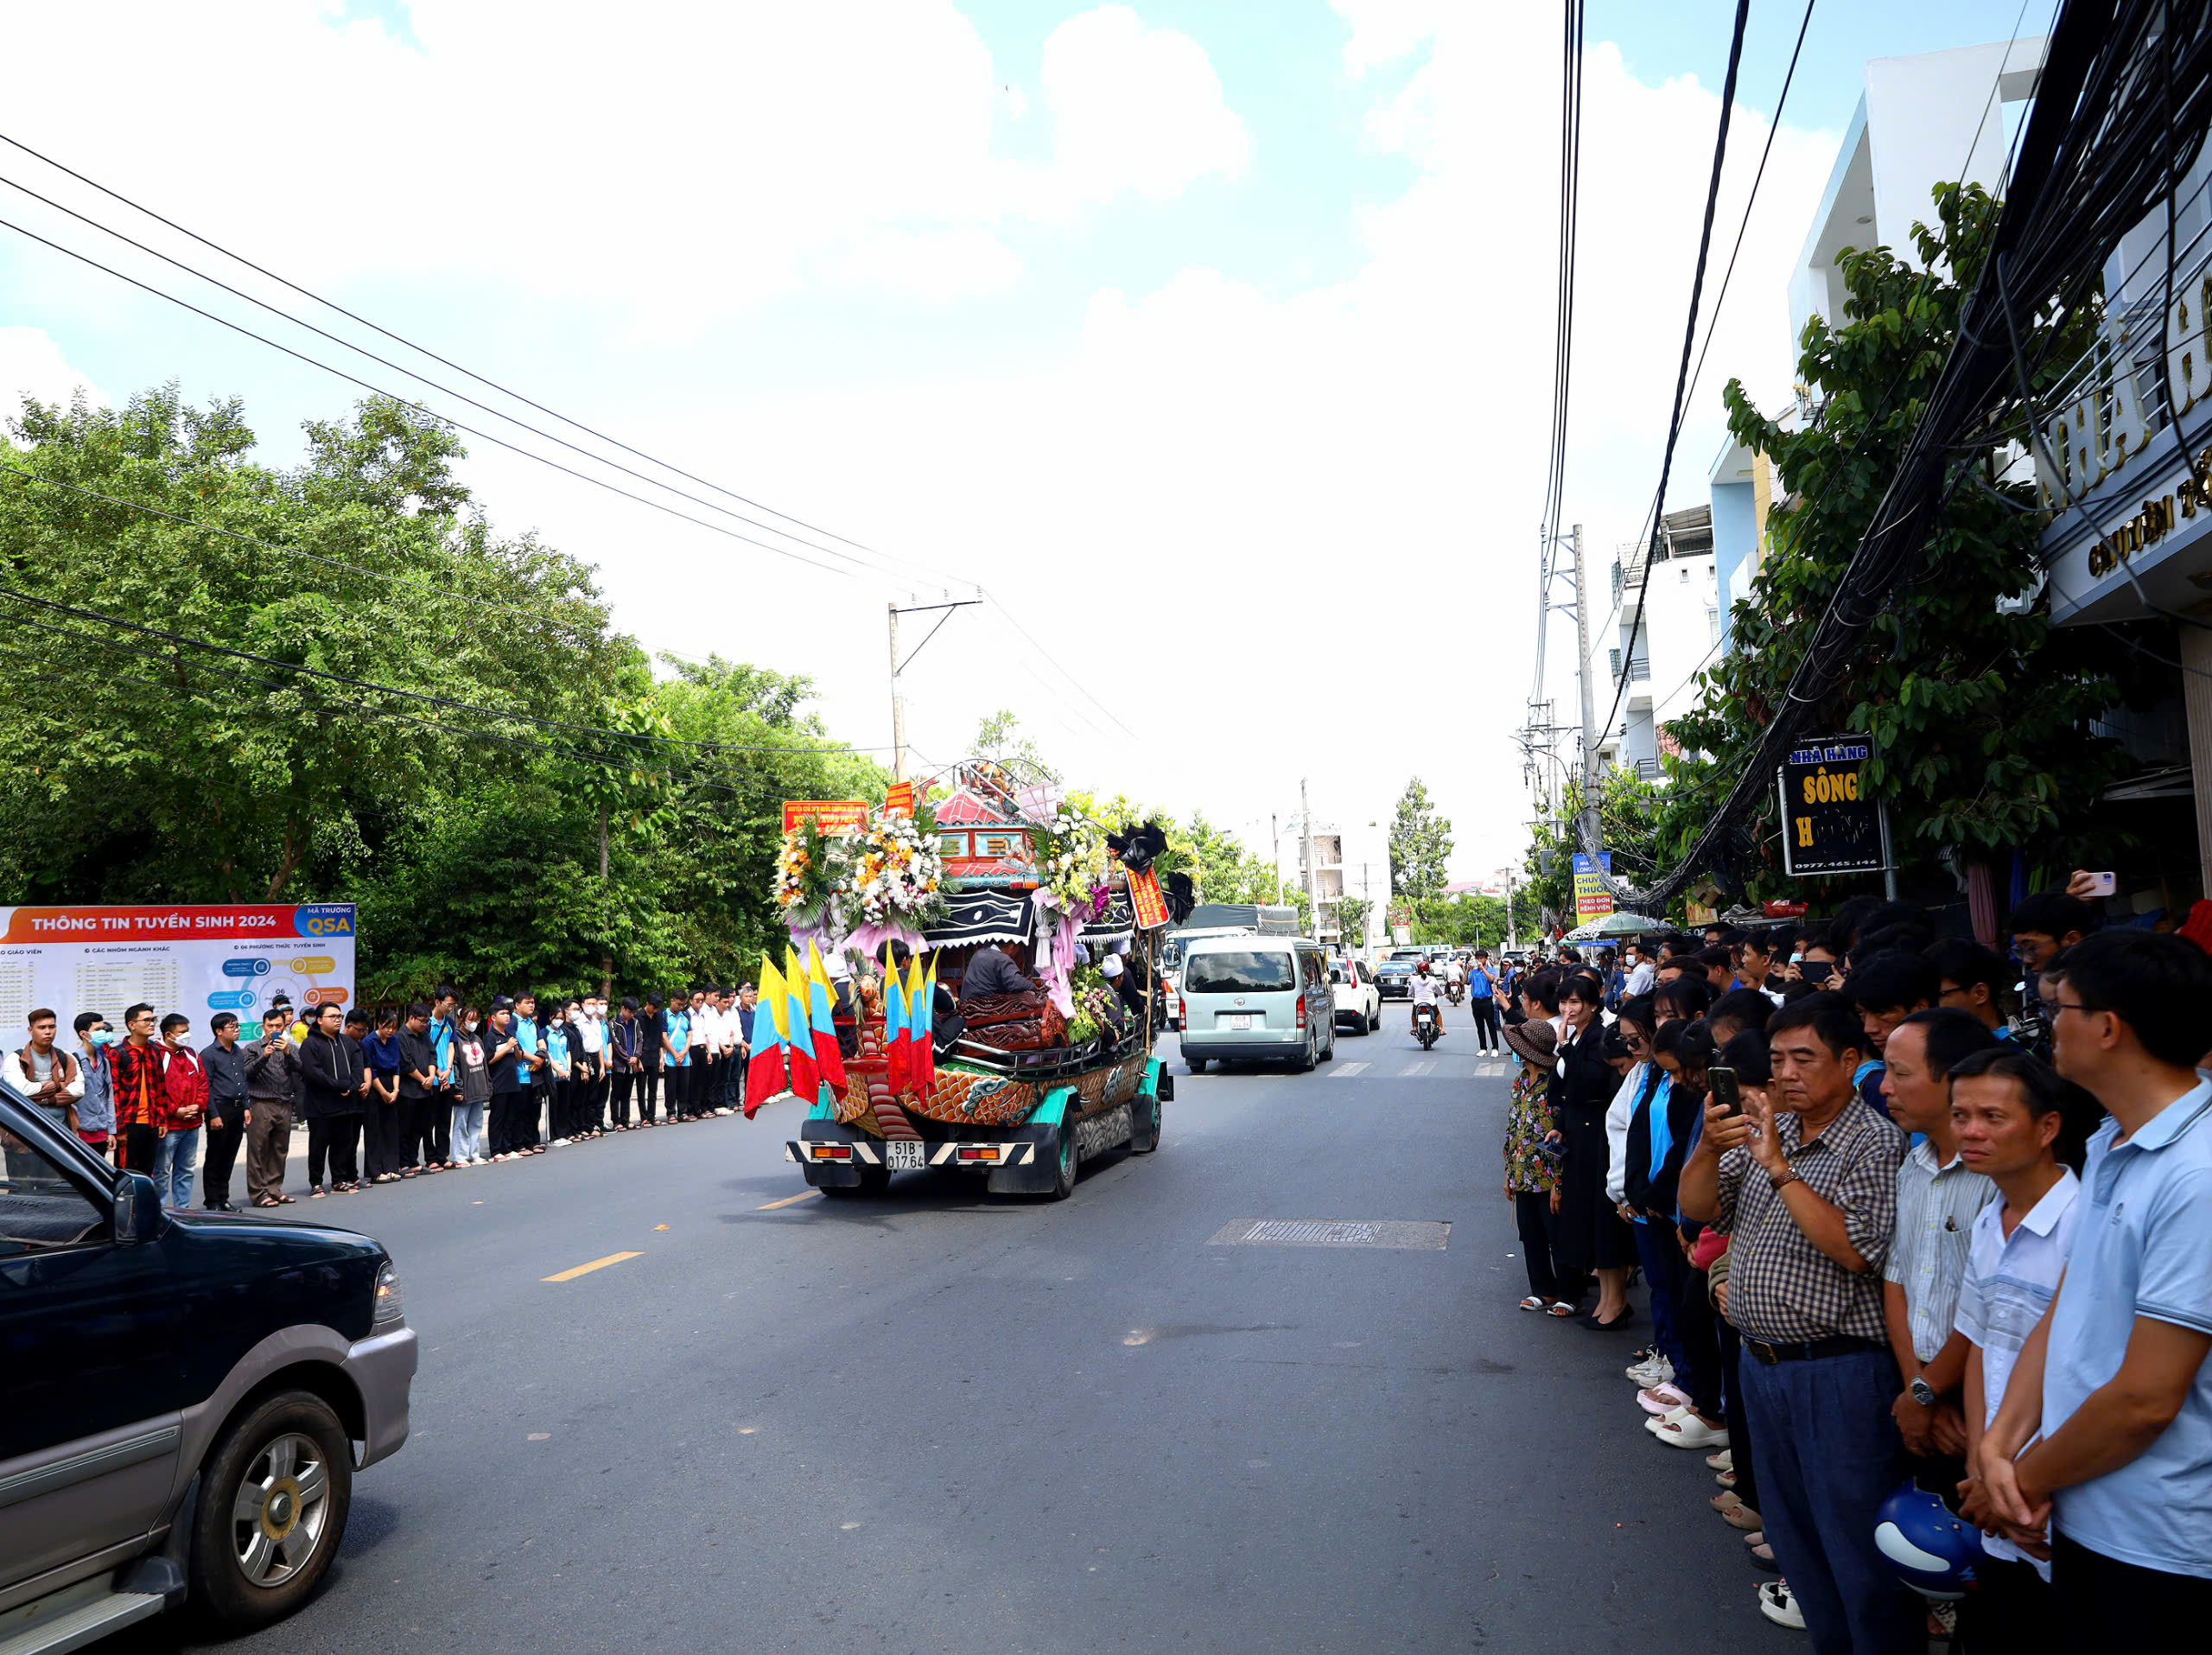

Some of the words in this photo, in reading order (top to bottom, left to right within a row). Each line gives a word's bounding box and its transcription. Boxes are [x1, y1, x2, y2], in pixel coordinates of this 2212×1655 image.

[1789, 746, 1823, 764] NHÀ
[1825, 744, 1868, 761] HÀNG
[1803, 767, 1858, 804] SÔNG
[1795, 859, 1878, 869] 0977.465.146
[31, 915, 97, 931] THÔNG
[100, 917, 130, 930] TIN
[135, 913, 191, 929] TUYỂN
[195, 916, 234, 928] SINH
[238, 915, 276, 927] 2024
[308, 917, 351, 936] QSA
[895, 1142, 915, 1155] 51B
[887, 1155, 924, 1168] 017.64
